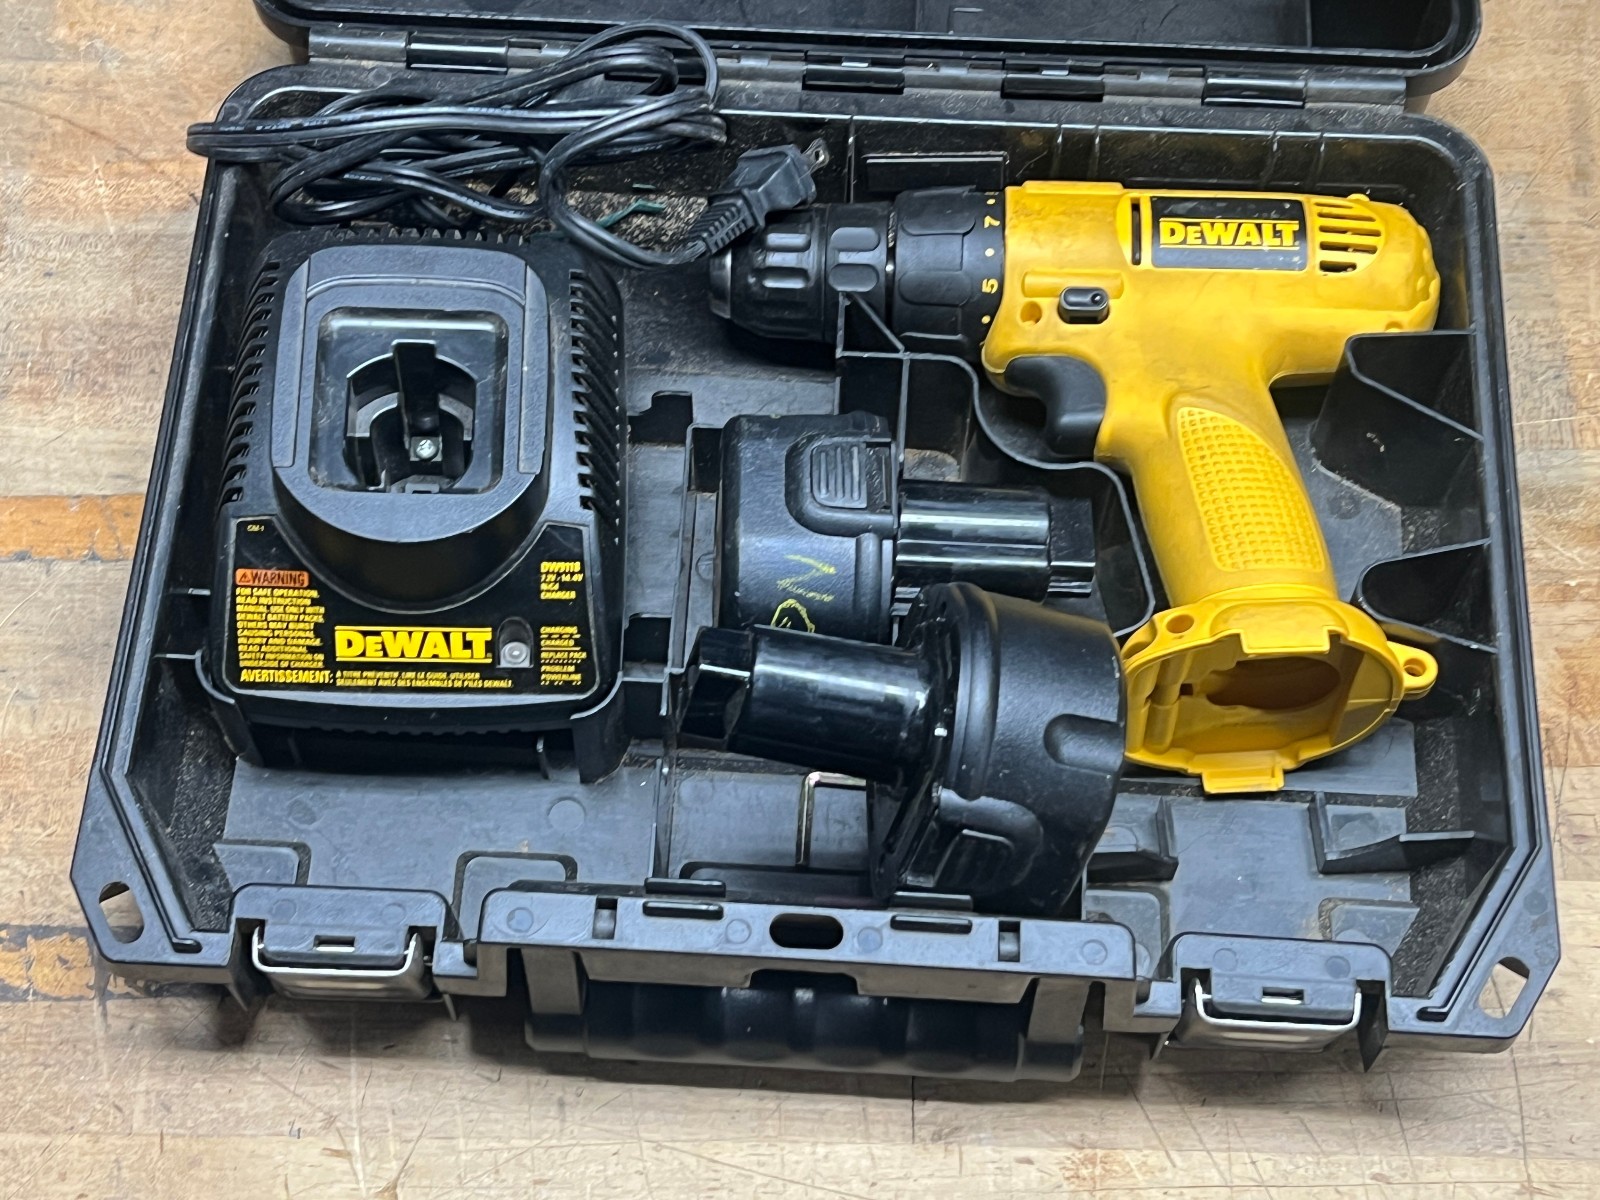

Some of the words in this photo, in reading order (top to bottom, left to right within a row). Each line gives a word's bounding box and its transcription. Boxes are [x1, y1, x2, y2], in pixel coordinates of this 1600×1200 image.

[984, 215, 1000, 228] 7
[982, 278, 998, 294] 5
[252, 571, 305, 586] WARNING
[240, 669, 333, 684] AVERTISSEMENT:
